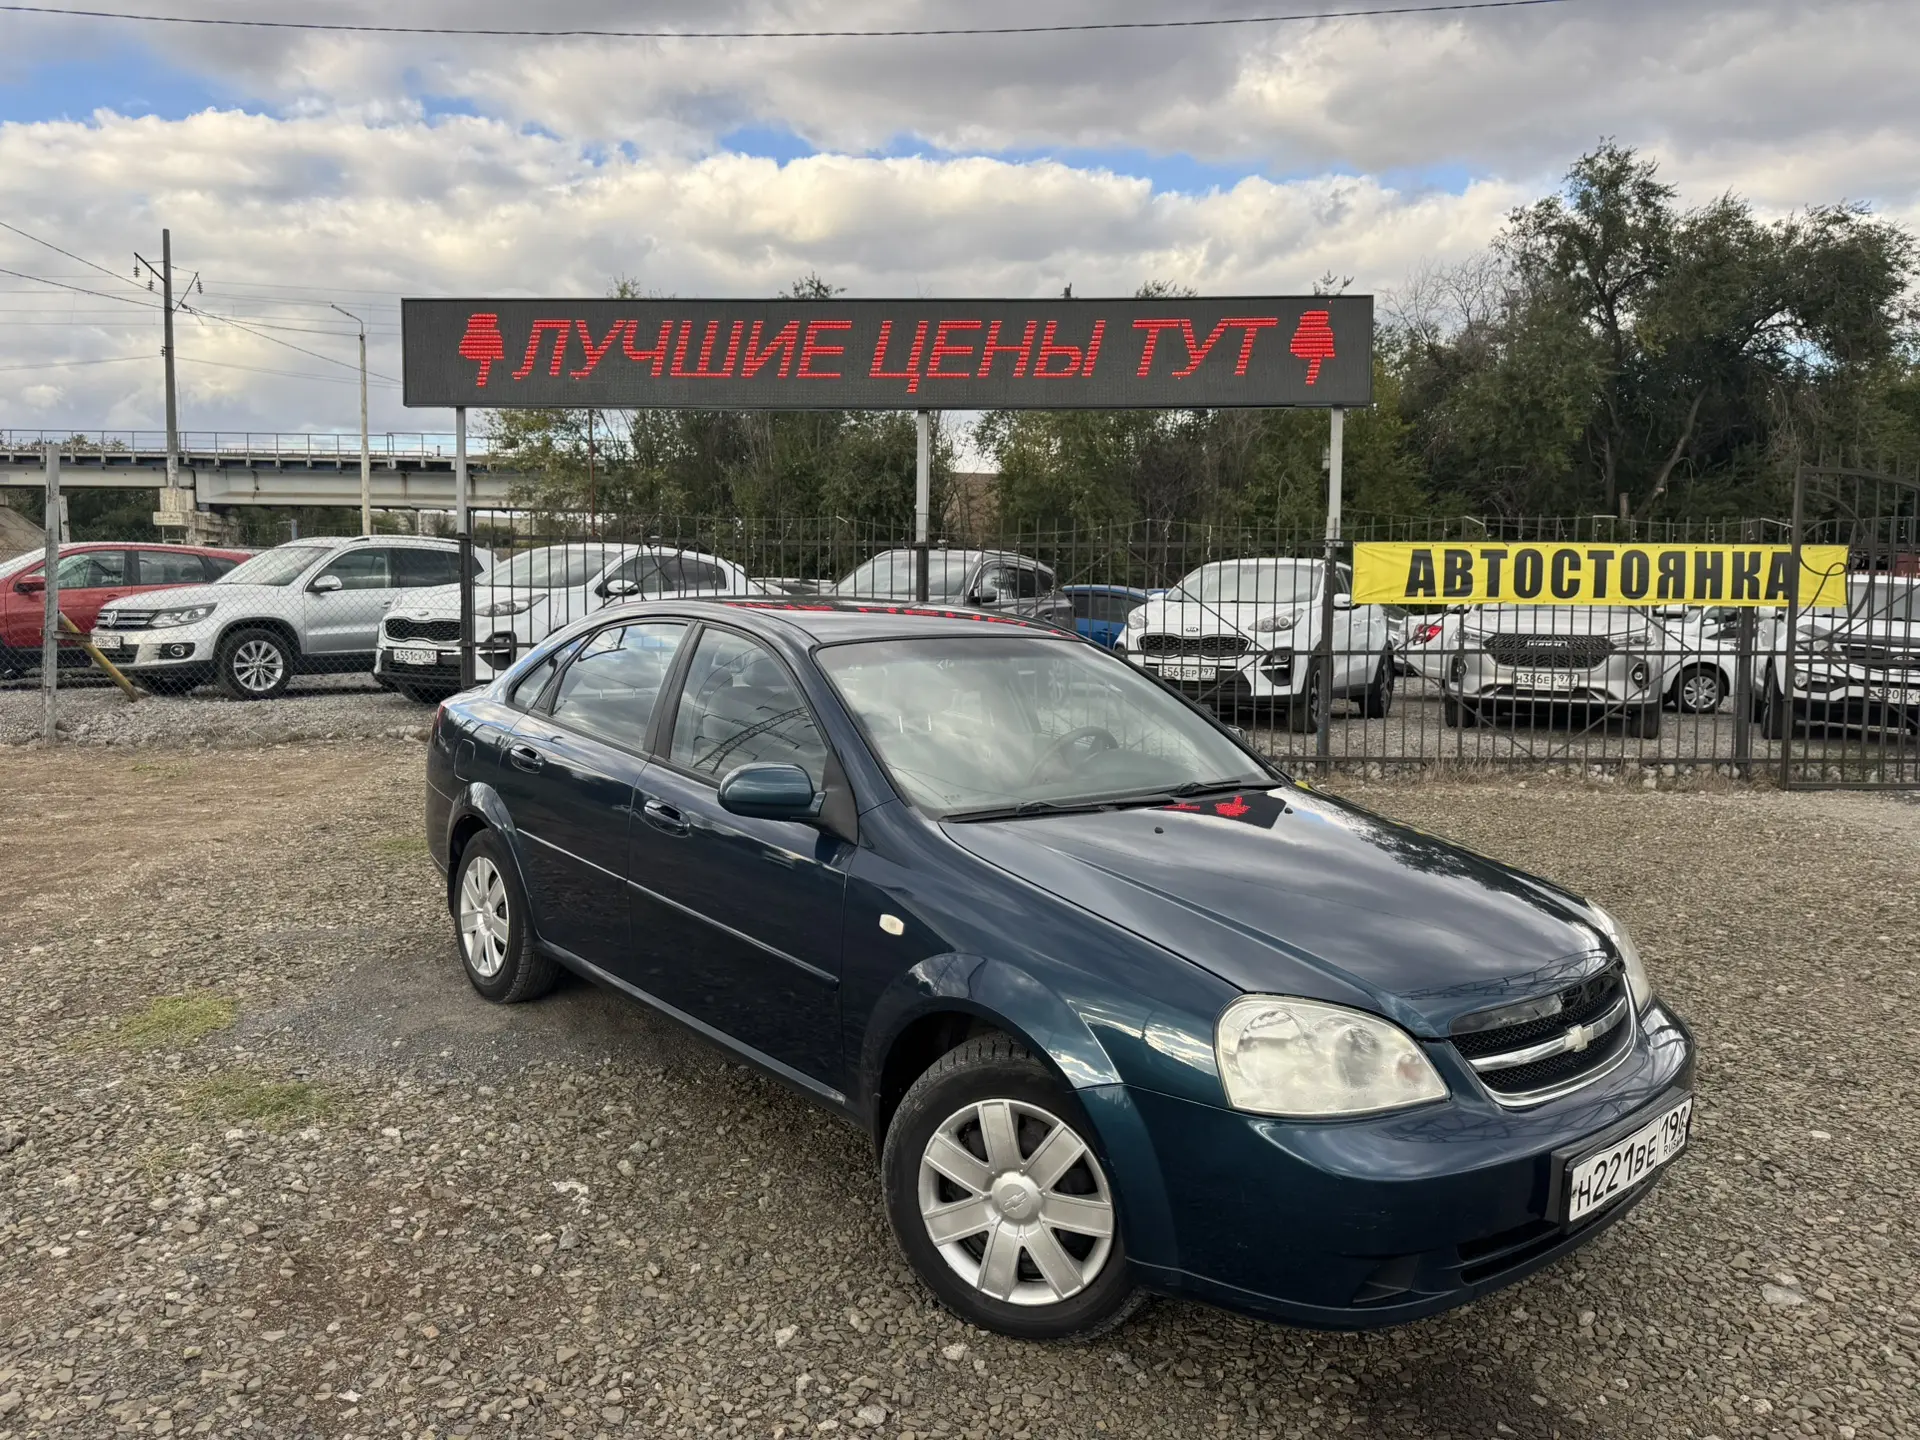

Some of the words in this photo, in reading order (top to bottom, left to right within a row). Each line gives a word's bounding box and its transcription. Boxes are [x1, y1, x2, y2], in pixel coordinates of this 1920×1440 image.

[512, 319, 852, 381] ЛУЧШИЕ
[869, 319, 1106, 393] ЦЕНЫ
[1132, 317, 1278, 378] ТУТ
[1405, 549, 1791, 600] АВТОСТОЯНКА
[1577, 1134, 1657, 1212] Н221ВЕ
